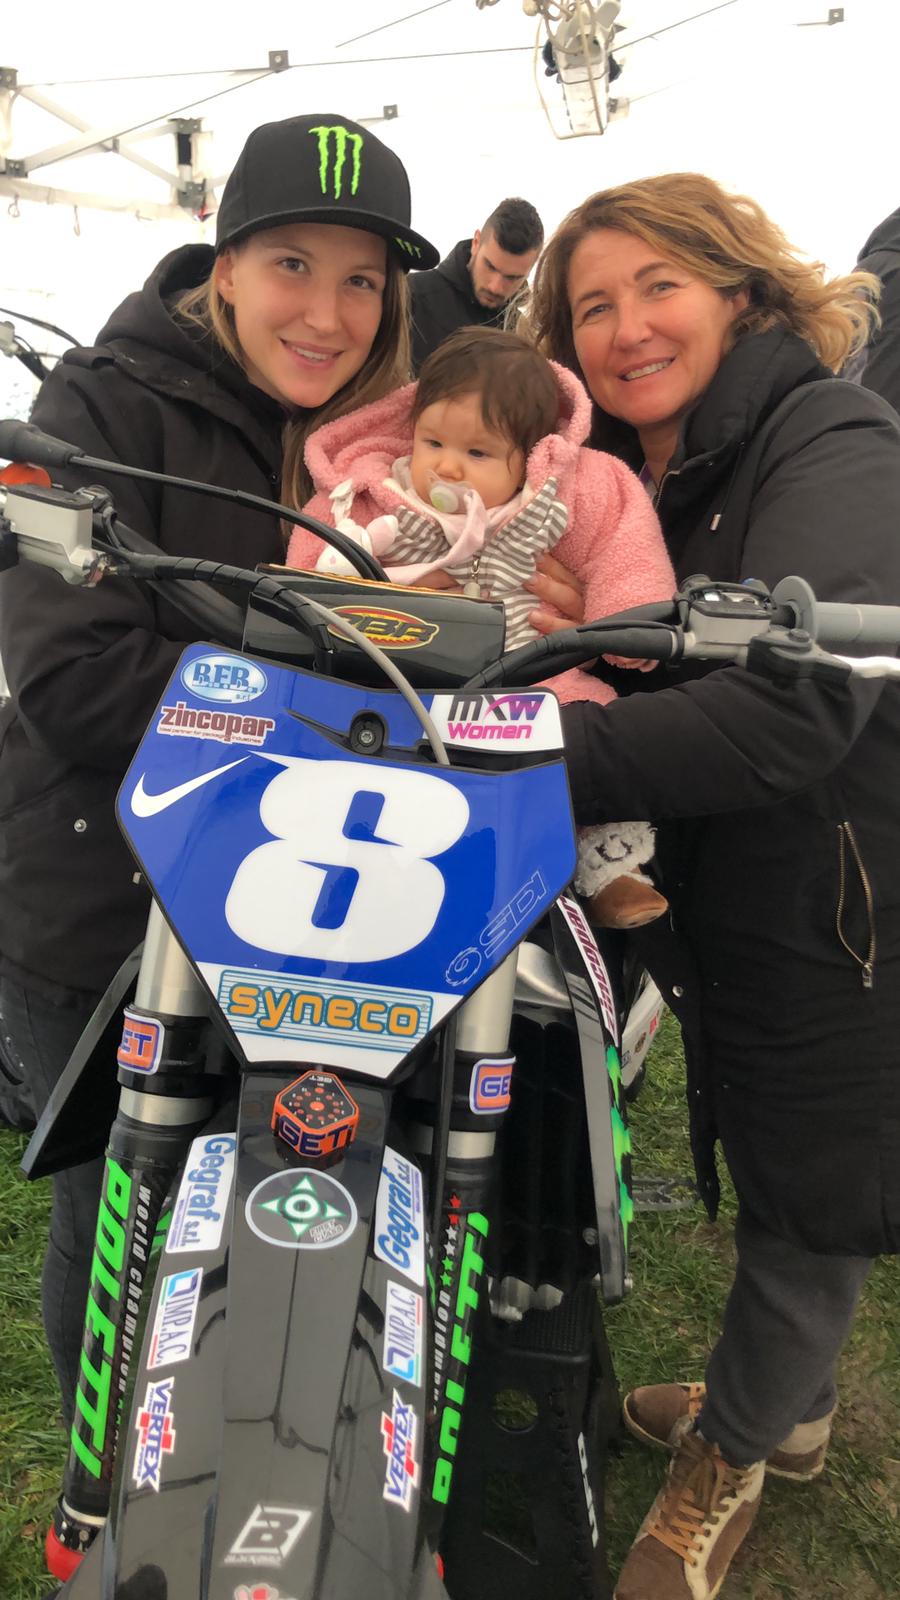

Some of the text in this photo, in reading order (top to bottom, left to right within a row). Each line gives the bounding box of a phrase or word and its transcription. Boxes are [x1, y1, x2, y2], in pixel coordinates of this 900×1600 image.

[160, 703, 274, 742] zincopar
[447, 722, 532, 740] Women
[225, 751, 470, 964] 8
[121, 1029, 152, 1056] ET
[227, 982, 421, 1039] syneco
[480, 1074, 512, 1098] GE
[187, 1136, 237, 1222] Gegraf
[377, 1167, 420, 1269] Gegraf
[133, 1184, 152, 1263] world
[70, 1157, 132, 1479] POLETTI
[141, 1382, 171, 1482] VERTEX
[387, 1404, 410, 1498] VERTEX
